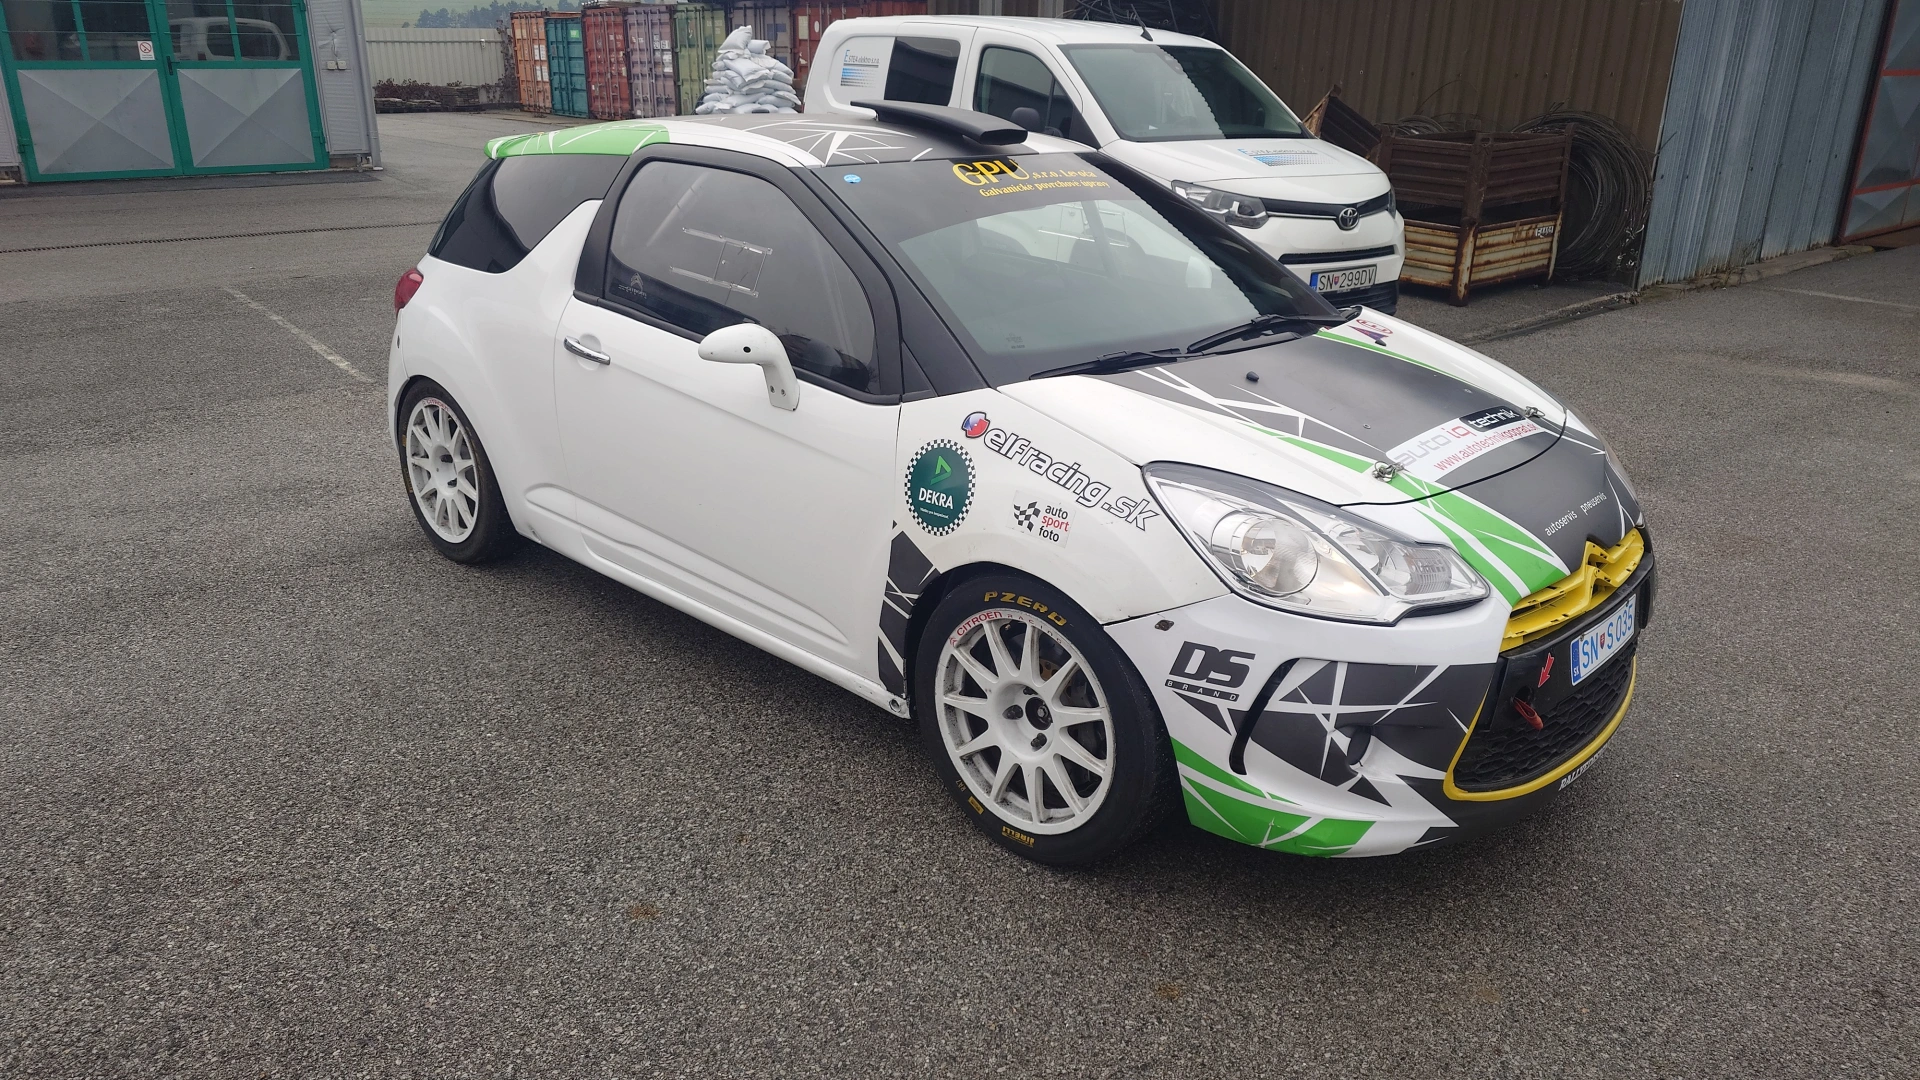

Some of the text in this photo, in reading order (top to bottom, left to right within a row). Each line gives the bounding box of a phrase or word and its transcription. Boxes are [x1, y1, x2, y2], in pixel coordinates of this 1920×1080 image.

[952, 159, 1030, 186] GPU
[979, 182, 1034, 197] Galvanické
[1318, 274, 1335, 291] SN
[1339, 268, 1375, 288] 299DV
[1394, 434, 1452, 467] auto
[1467, 408, 1520, 428] technik
[984, 428, 1160, 531] elfracing.sk
[918, 487, 954, 510] DEKRA
[1041, 515, 1070, 532] sport
[1044, 504, 1068, 520] auto
[1544, 491, 1607, 536] autoservis pneuservis
[1038, 525, 1060, 542] foto
[1582, 632, 1599, 669] SN
[1169, 641, 1256, 689] DS
[1167, 679, 1238, 702] BRAND
